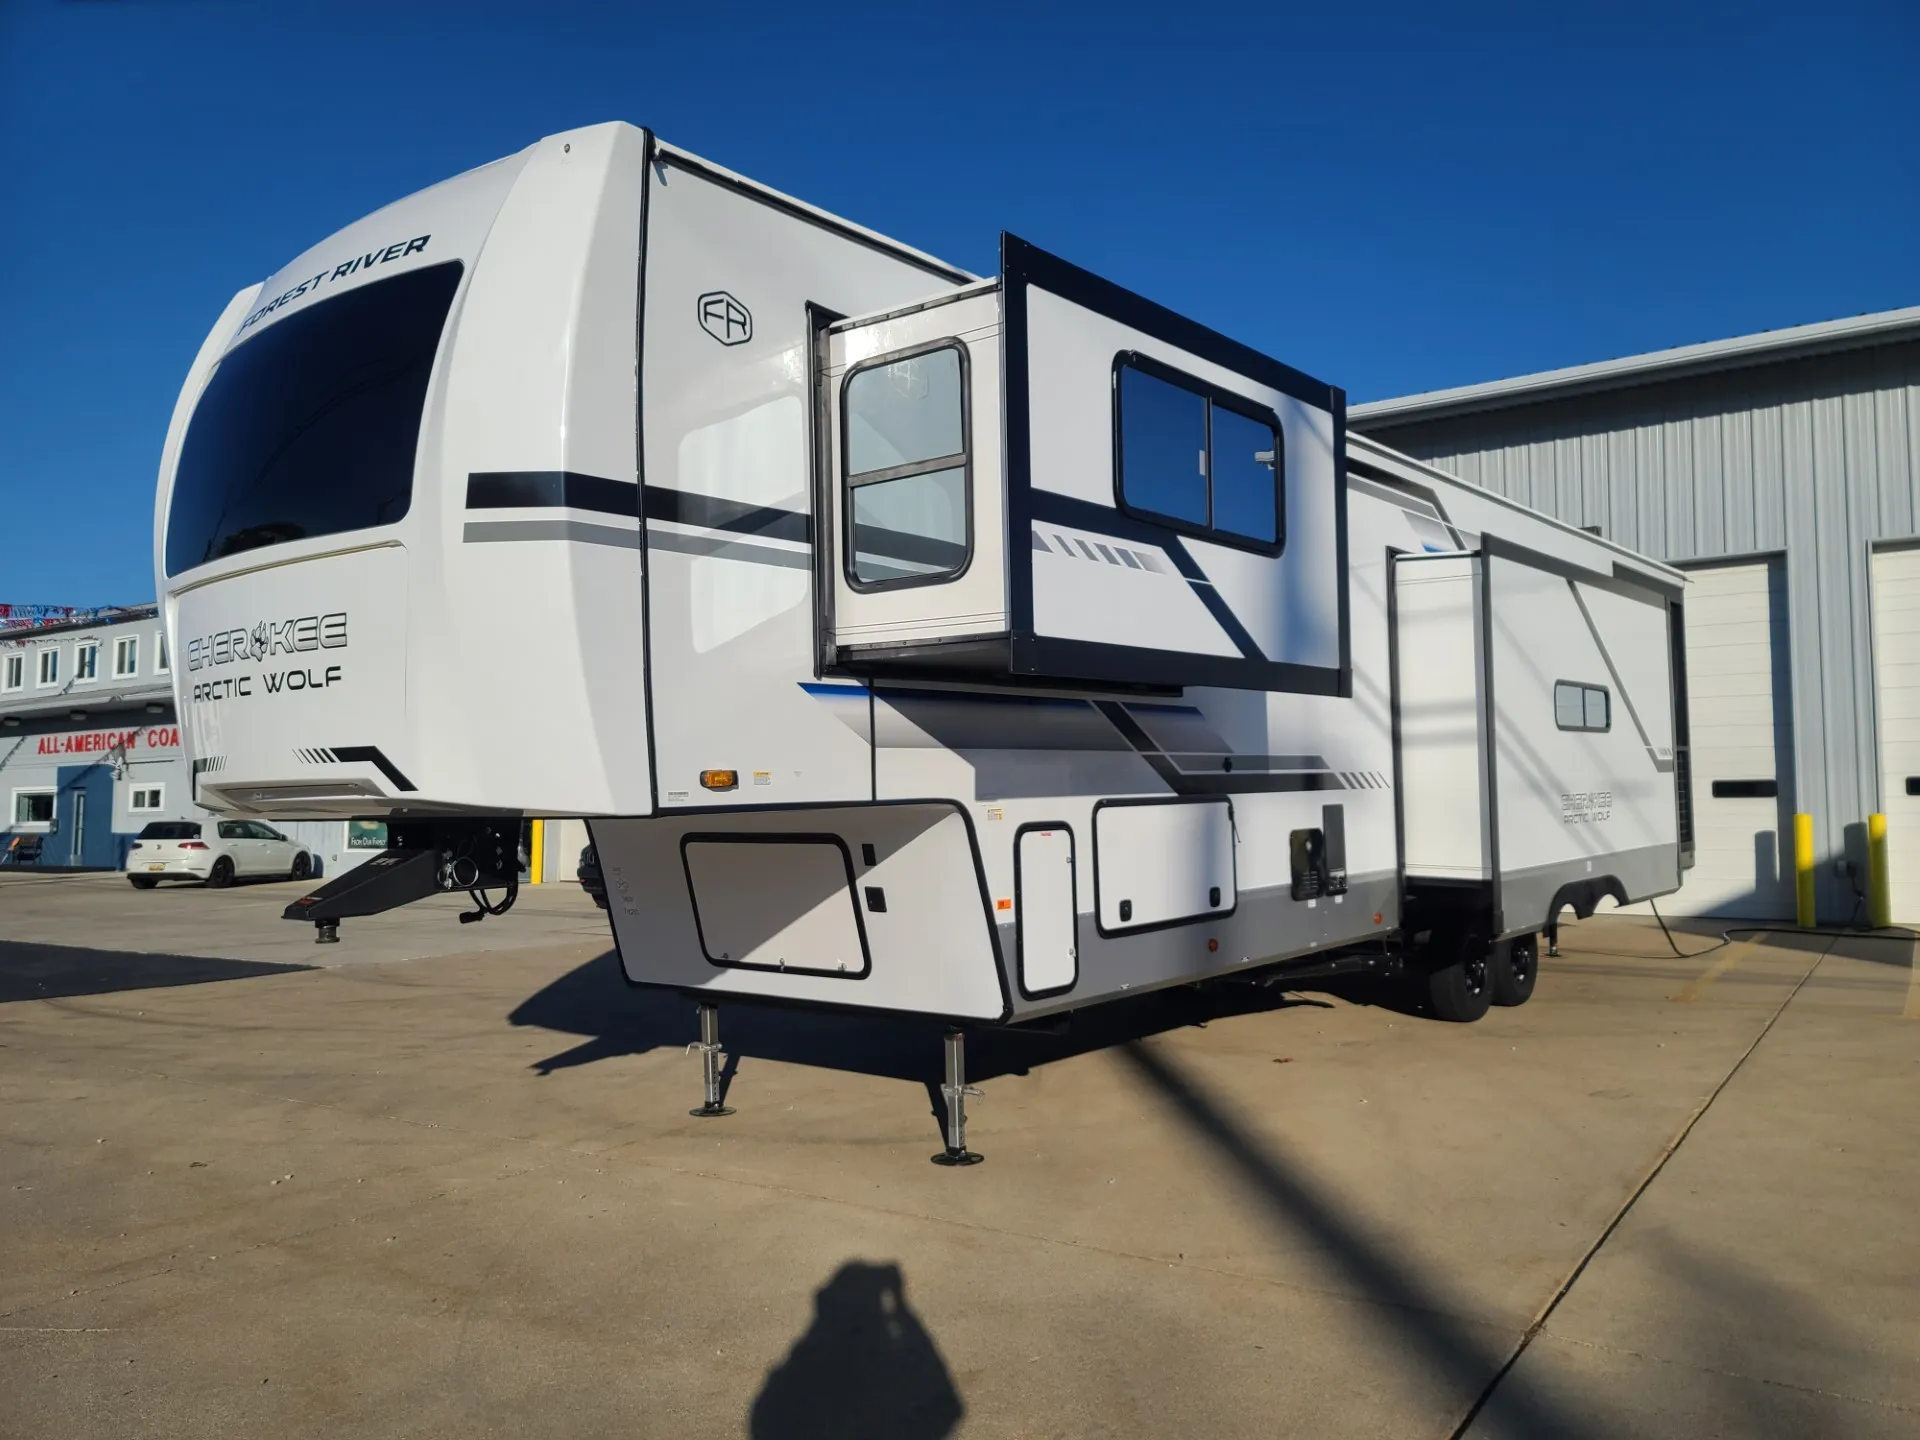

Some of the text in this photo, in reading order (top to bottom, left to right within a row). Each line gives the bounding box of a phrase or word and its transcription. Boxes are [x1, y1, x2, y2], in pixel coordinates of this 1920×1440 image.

[237, 234, 431, 336] FOREST RIVER
[194, 666, 342, 703] ARCTIC WOLF
[37, 731, 137, 755] ALL-AMERICAN
[1563, 810, 1610, 825] ARCTIC WOLF
